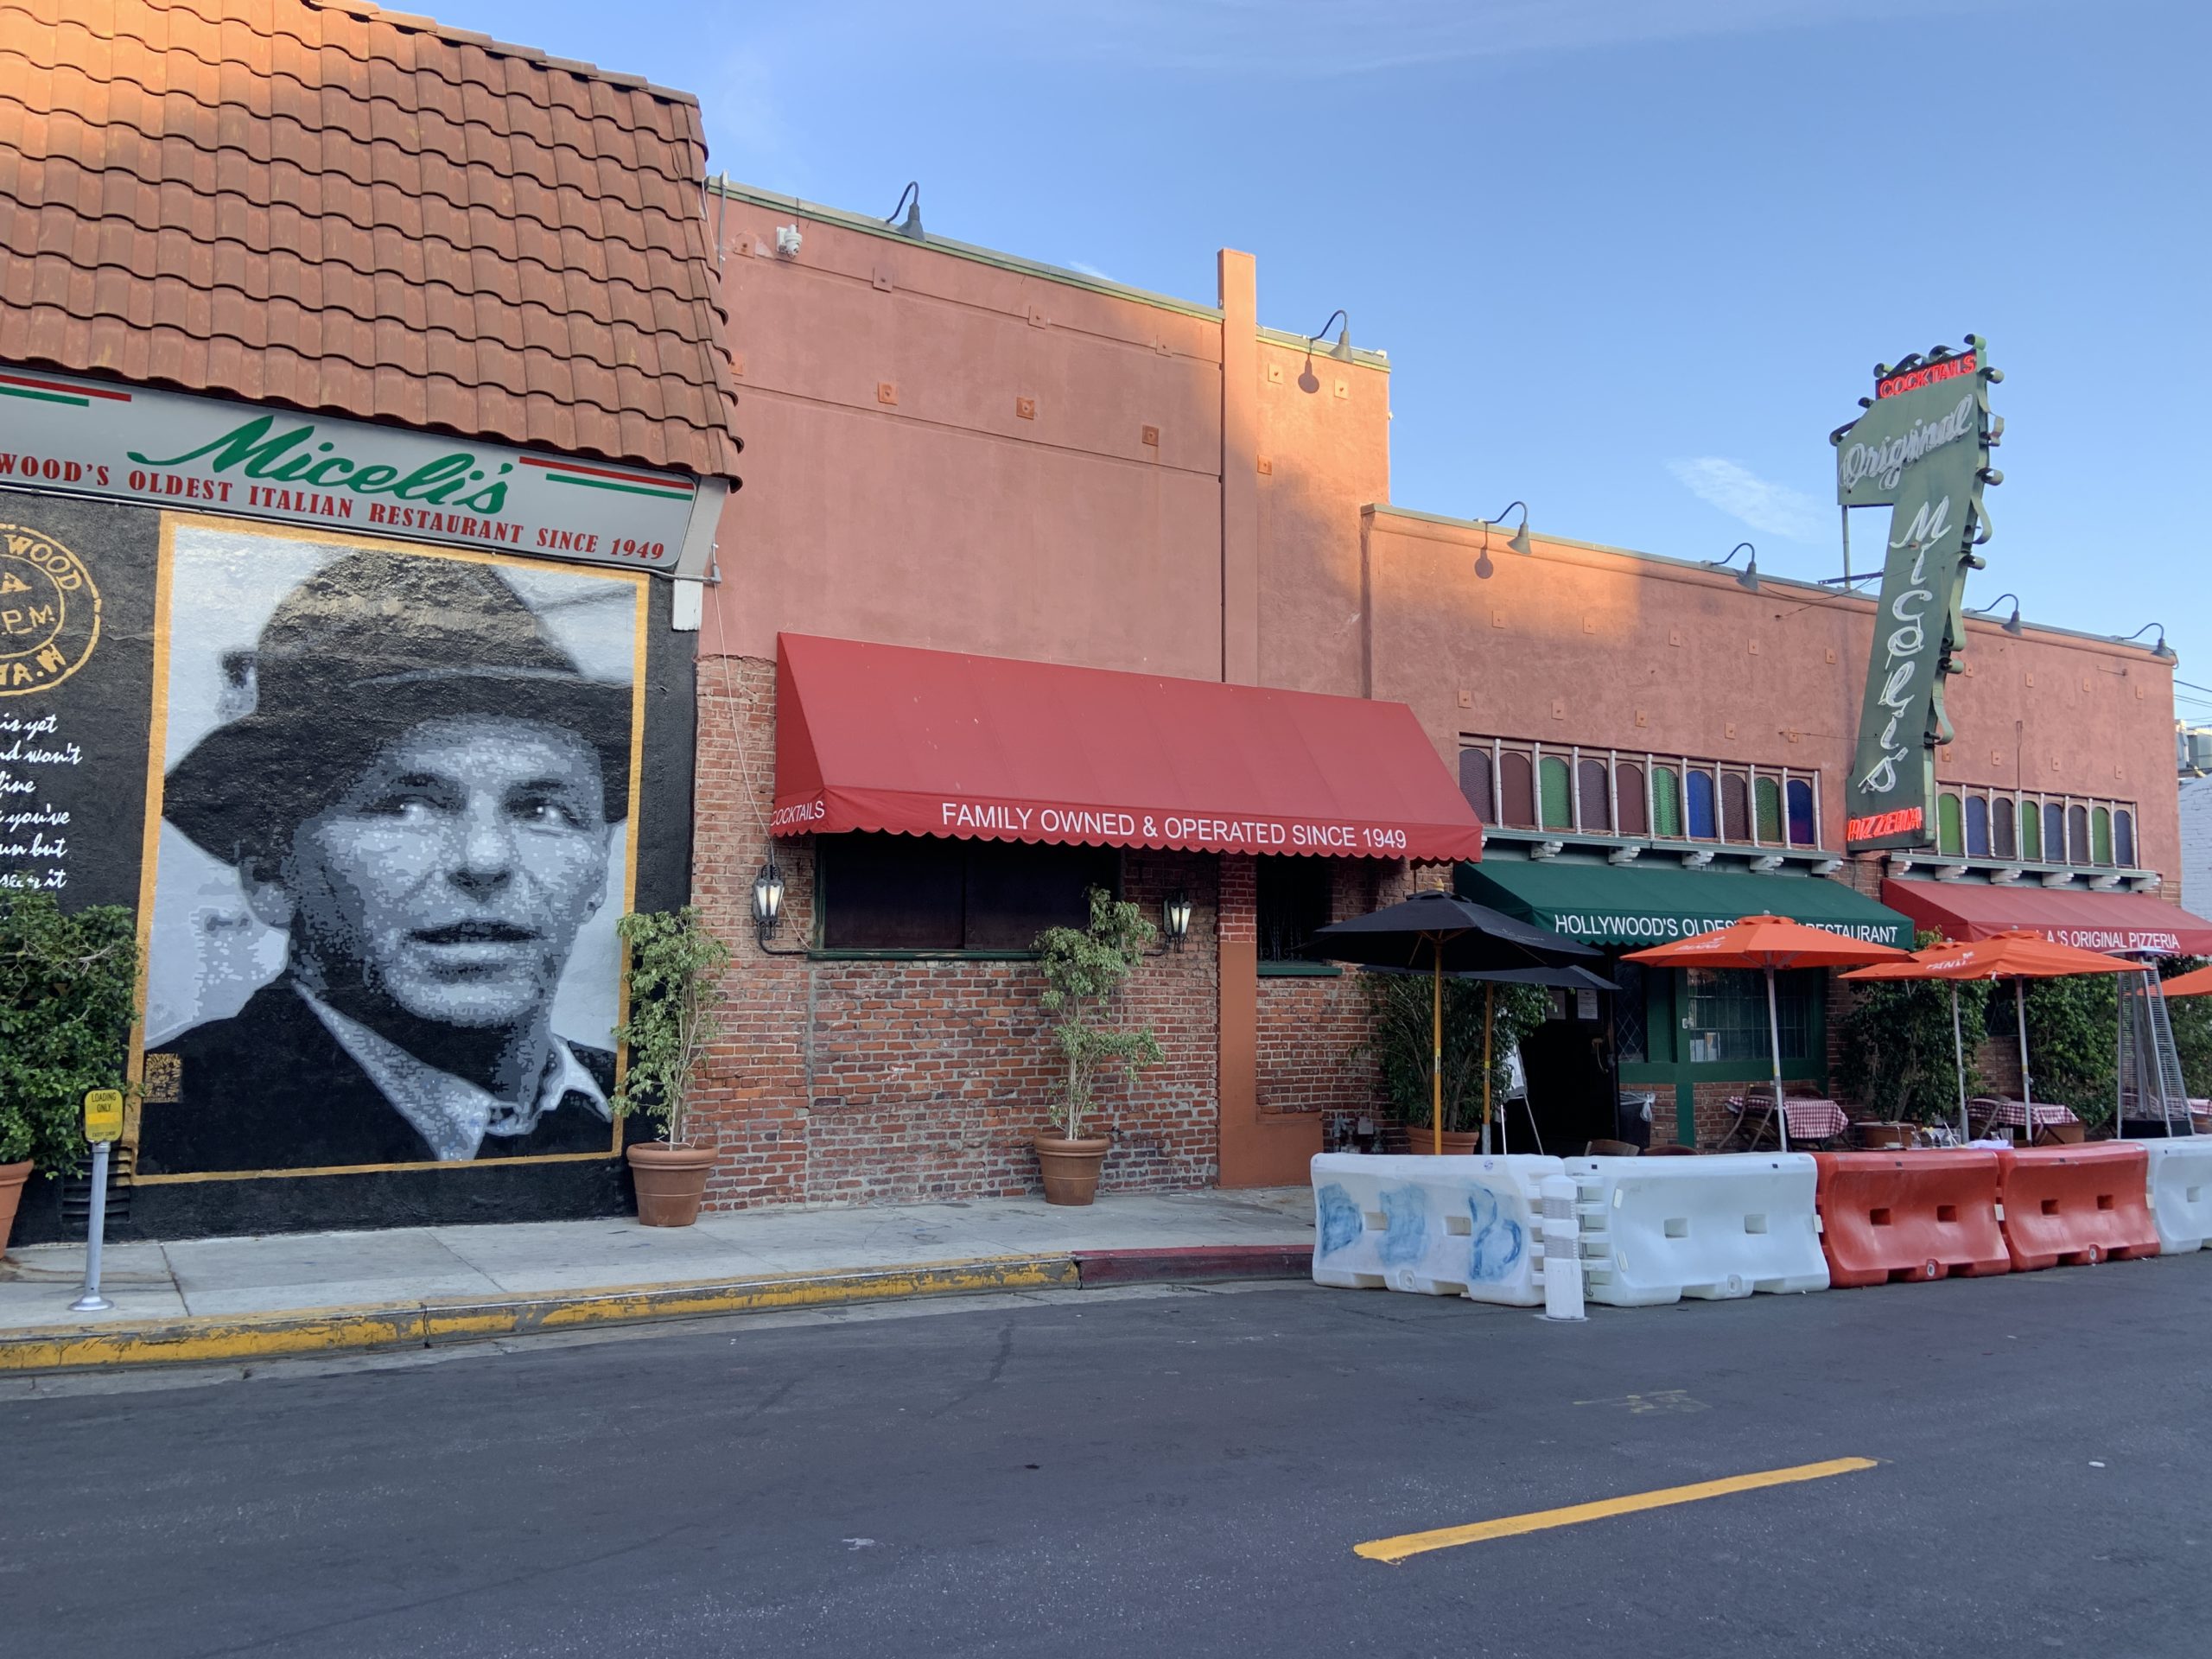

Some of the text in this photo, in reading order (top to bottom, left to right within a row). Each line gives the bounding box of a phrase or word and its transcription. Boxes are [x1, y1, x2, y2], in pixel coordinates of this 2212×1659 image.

[1879, 354, 1977, 398] COCKTAILS
[1839, 393, 1974, 490] Original
[127, 415, 513, 513] Miceli's
[0, 453, 664, 560] WOOD'S OLDEST ITALIAN RESTAURANT SINCE 1949
[4, 534, 83, 590] WOOD
[23, 714, 58, 741] yet
[23, 742, 83, 766] won't
[5, 803, 71, 833] you've
[771, 800, 825, 827] COCKTAILS
[942, 802, 1407, 849] FAMILY OWNED & OPERATED SINCE 1949
[1847, 806, 1923, 842] PIZZERIA
[29, 833, 68, 858] but
[43, 868, 67, 889] it
[1554, 914, 1679, 937] HOLLYWOOD'S
[2071, 931, 2126, 949] ORIGINAL
[2128, 932, 2180, 950] PIZZERIA
[92, 1092, 117, 1103] LOADING
[97, 1103, 111, 1113] ONLY
